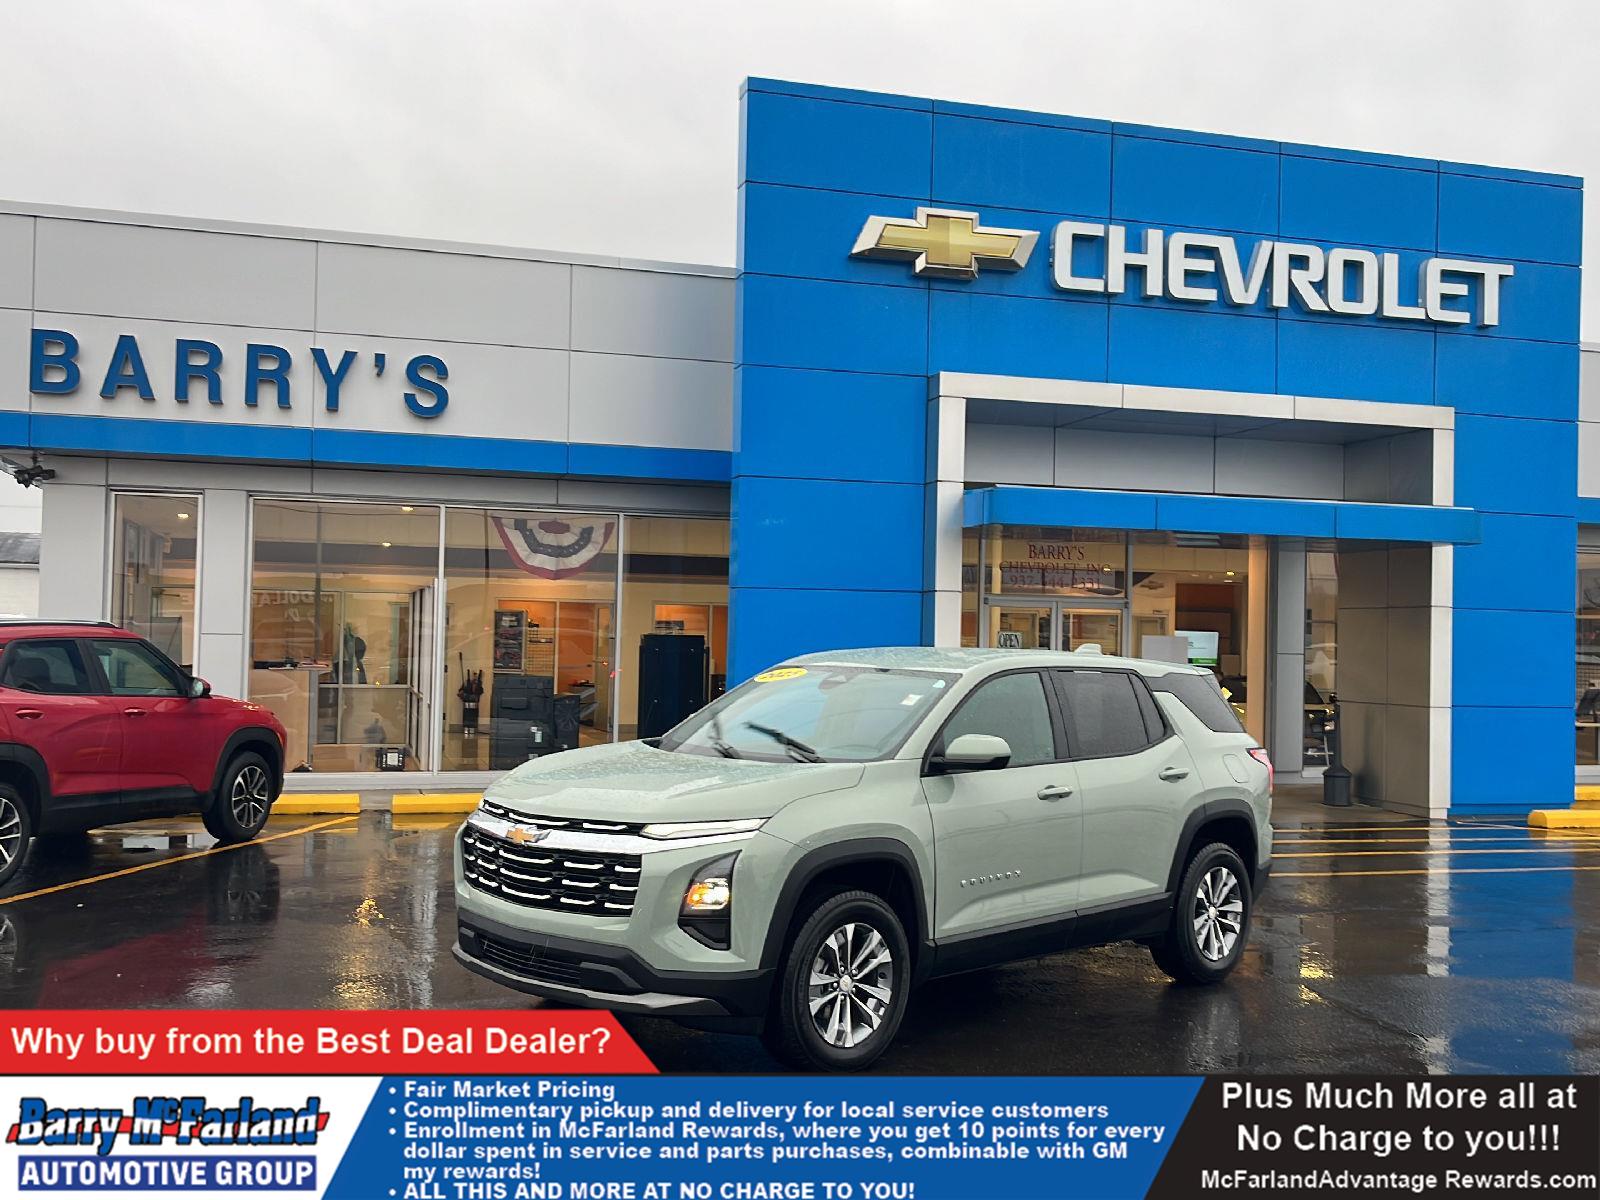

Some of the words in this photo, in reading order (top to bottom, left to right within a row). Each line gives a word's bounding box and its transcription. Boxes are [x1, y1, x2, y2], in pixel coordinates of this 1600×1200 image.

[1050, 220, 1514, 327] CHEVROLET
[29, 328, 450, 419] BARRY'S
[1028, 543, 1085, 561] BARRY'S
[998, 633, 1021, 648] OPEN
[959, 869, 1021, 888] EQUINOX
